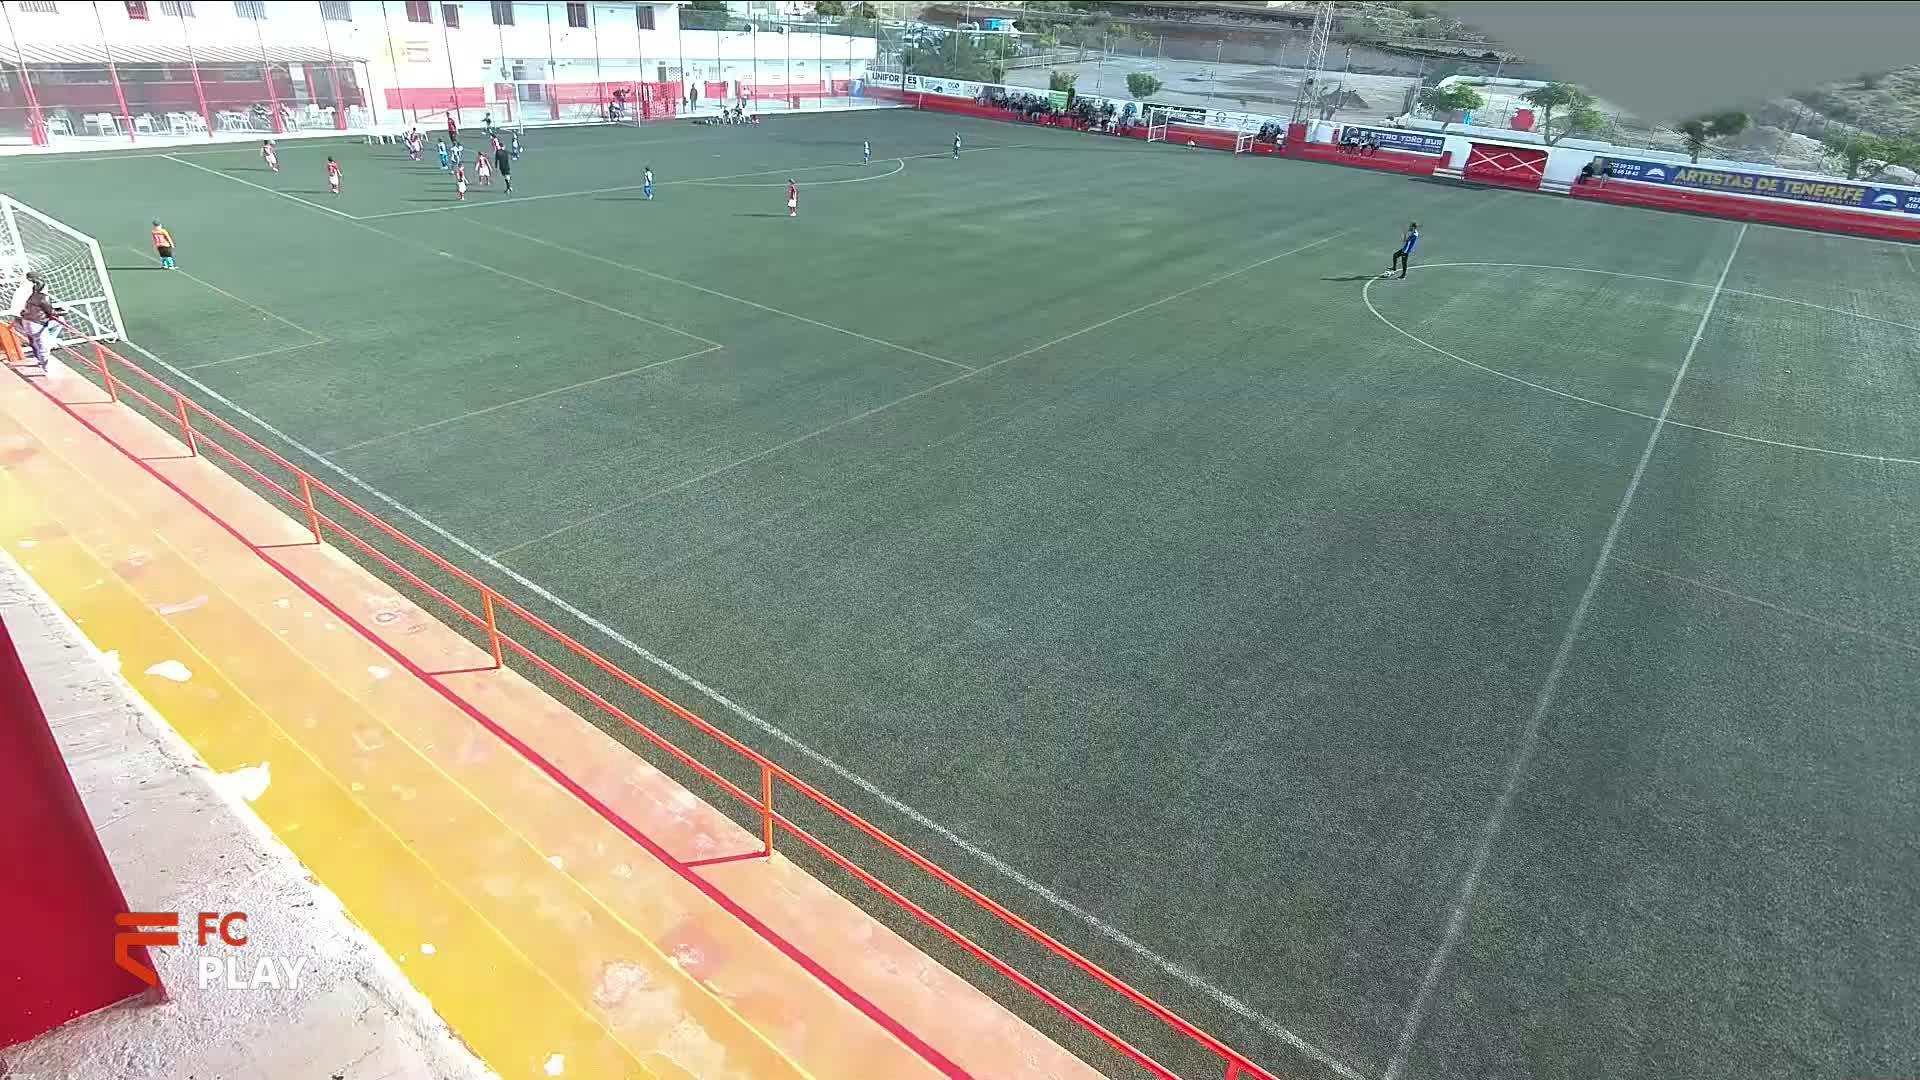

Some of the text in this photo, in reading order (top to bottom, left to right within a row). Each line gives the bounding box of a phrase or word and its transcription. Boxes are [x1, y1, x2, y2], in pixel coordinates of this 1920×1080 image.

[872, 72, 917, 85] UNIFORES
[1675, 168, 1753, 189] ARTISTAS
[1756, 177, 1777, 191] DE
[1783, 180, 1865, 201] TENERIFE
